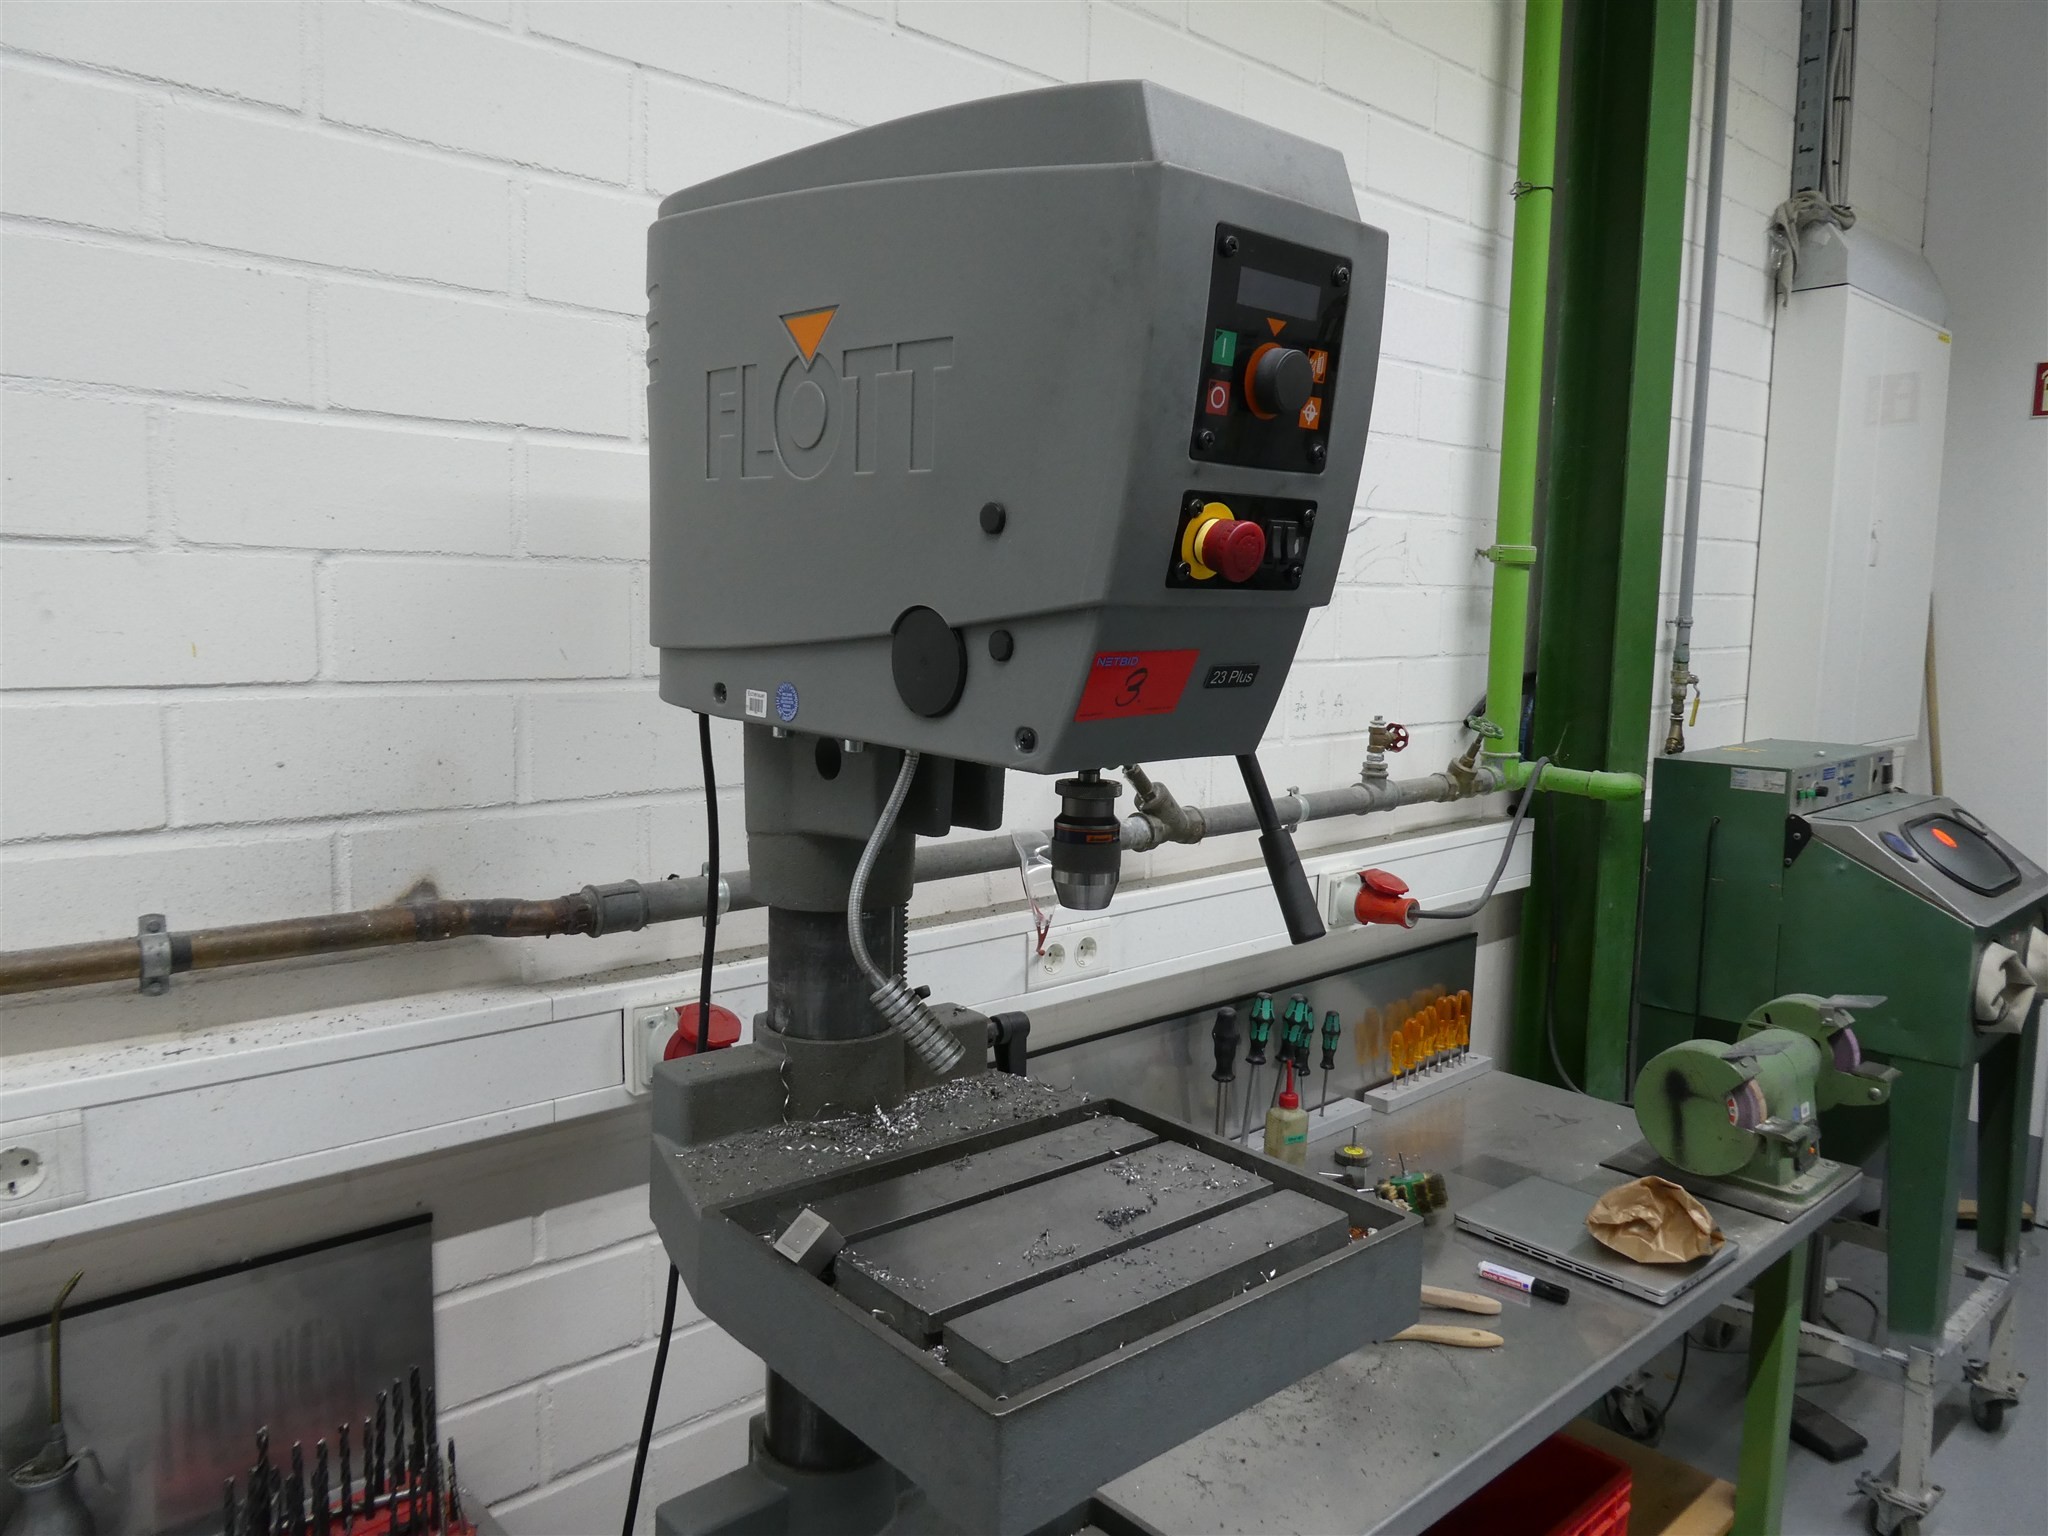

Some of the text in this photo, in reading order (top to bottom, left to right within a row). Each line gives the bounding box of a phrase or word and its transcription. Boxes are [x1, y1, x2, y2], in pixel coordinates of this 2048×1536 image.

[705, 336, 954, 481] FLOTT
[1097, 656, 1139, 667] NETBID
[1210, 670, 1254, 684] 23 Plus
